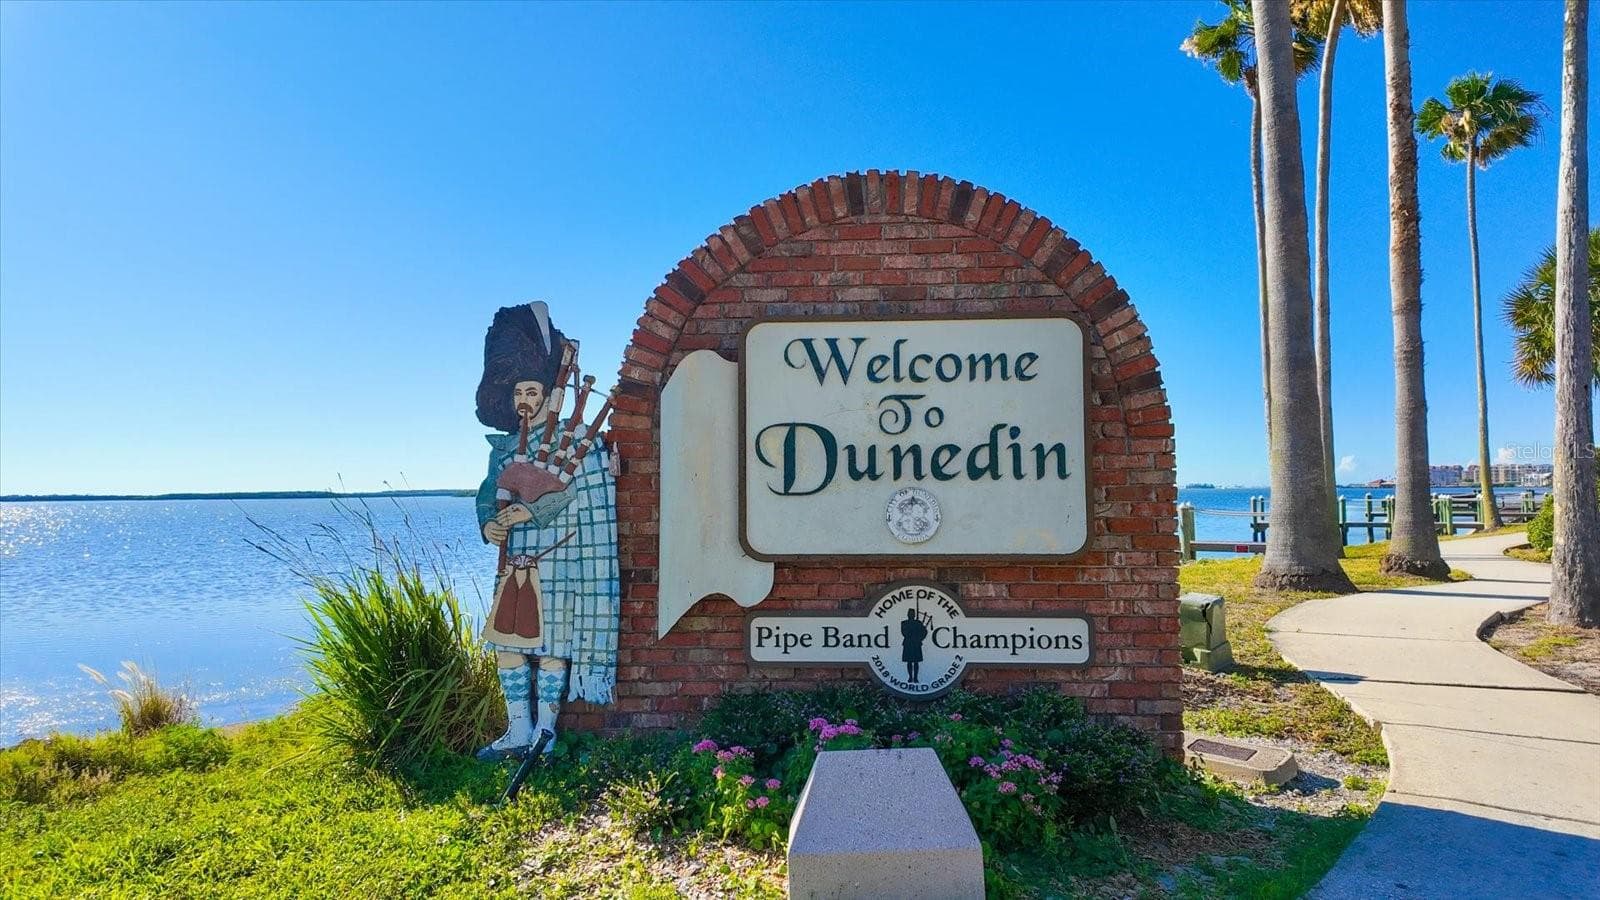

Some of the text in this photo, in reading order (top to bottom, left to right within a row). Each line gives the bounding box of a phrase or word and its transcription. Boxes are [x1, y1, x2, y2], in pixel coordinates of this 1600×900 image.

[783, 337, 1039, 386] Welcome
[878, 394, 945, 435] To
[755, 422, 1072, 496] Dunedin
[875, 589, 959, 619] HOME OF THE
[755, 626, 1083, 654] Pipe Band Champions
[871, 654, 890, 678] 2018
[890, 676, 928, 692] WORLD
[931, 662, 960, 688] GRADE
